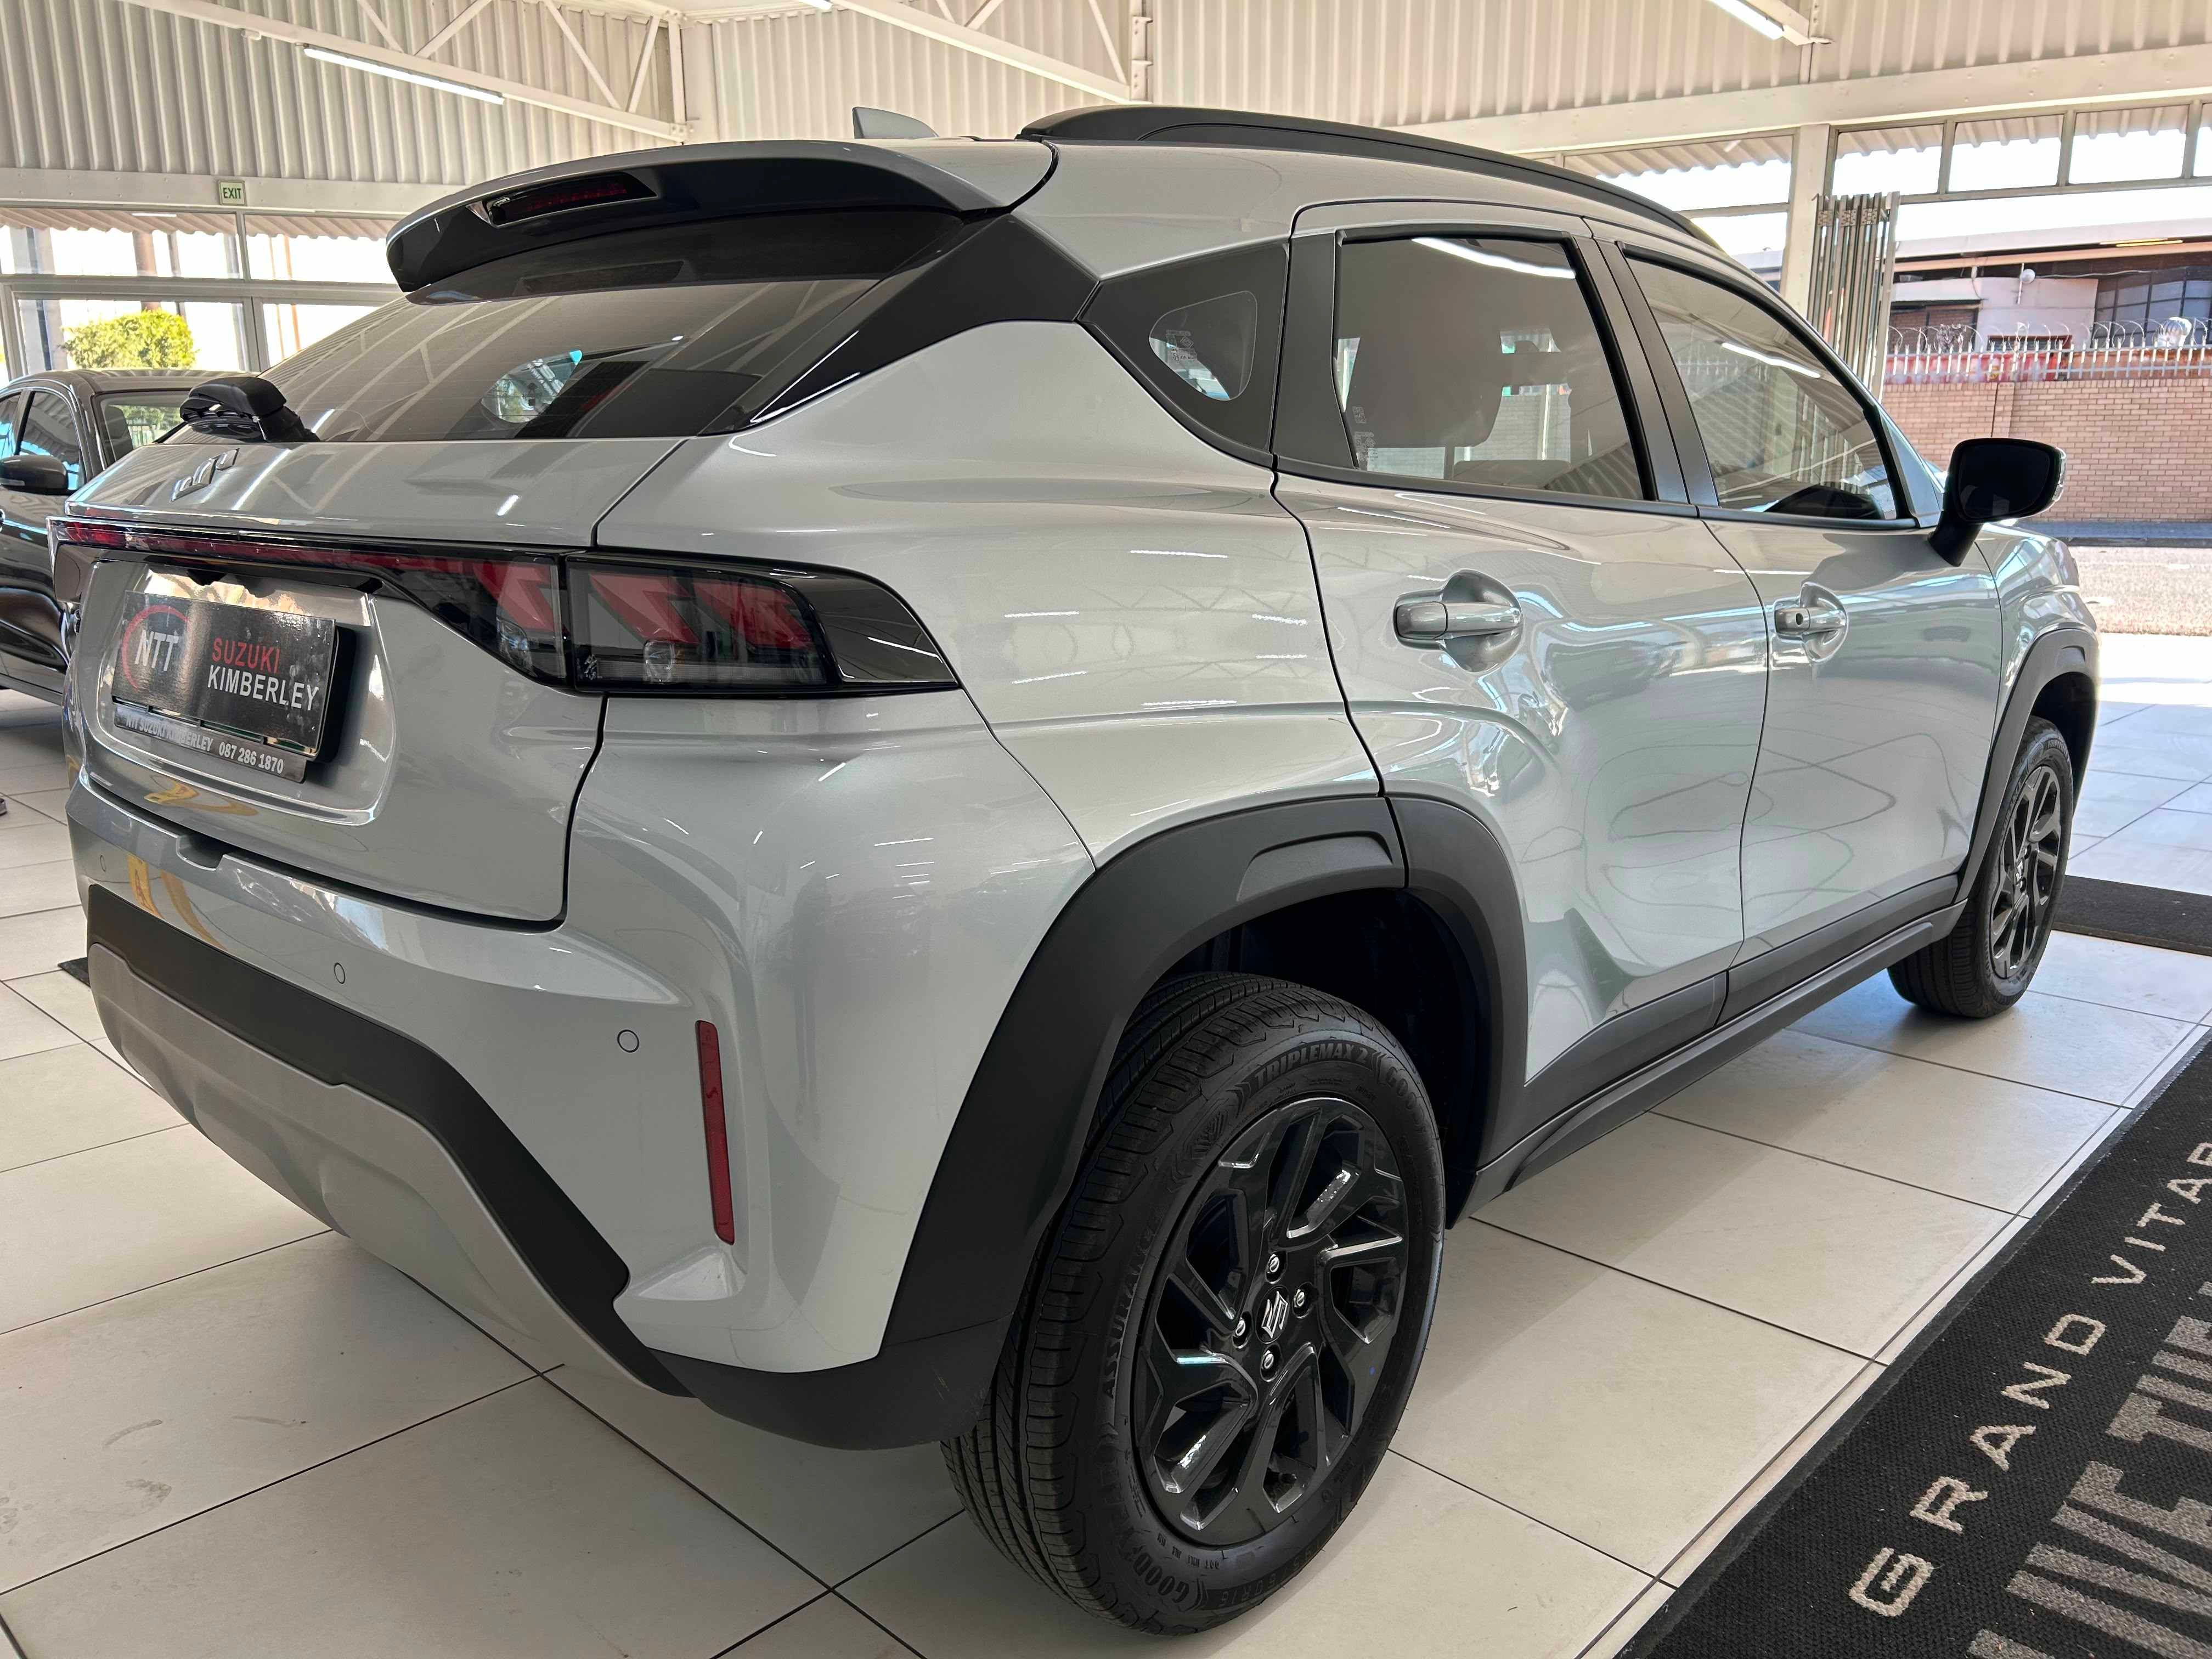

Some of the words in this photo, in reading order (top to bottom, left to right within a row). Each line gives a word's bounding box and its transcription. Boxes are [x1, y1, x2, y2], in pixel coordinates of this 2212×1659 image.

[223, 188, 241, 199] EXIT
[135, 629, 179, 671] NTT
[212, 636, 281, 674] SUZUKI
[207, 664, 319, 711] KIMBERLEY
[219, 741, 237, 759] 087
[238, 747, 256, 766] 286
[258, 753, 284, 775] 1870
[1255, 1042, 1355, 1090] TRIPLEMAX
[1356, 1047, 1369, 1064] 2
[1849, 1313, 2107, 1617] GRAND
